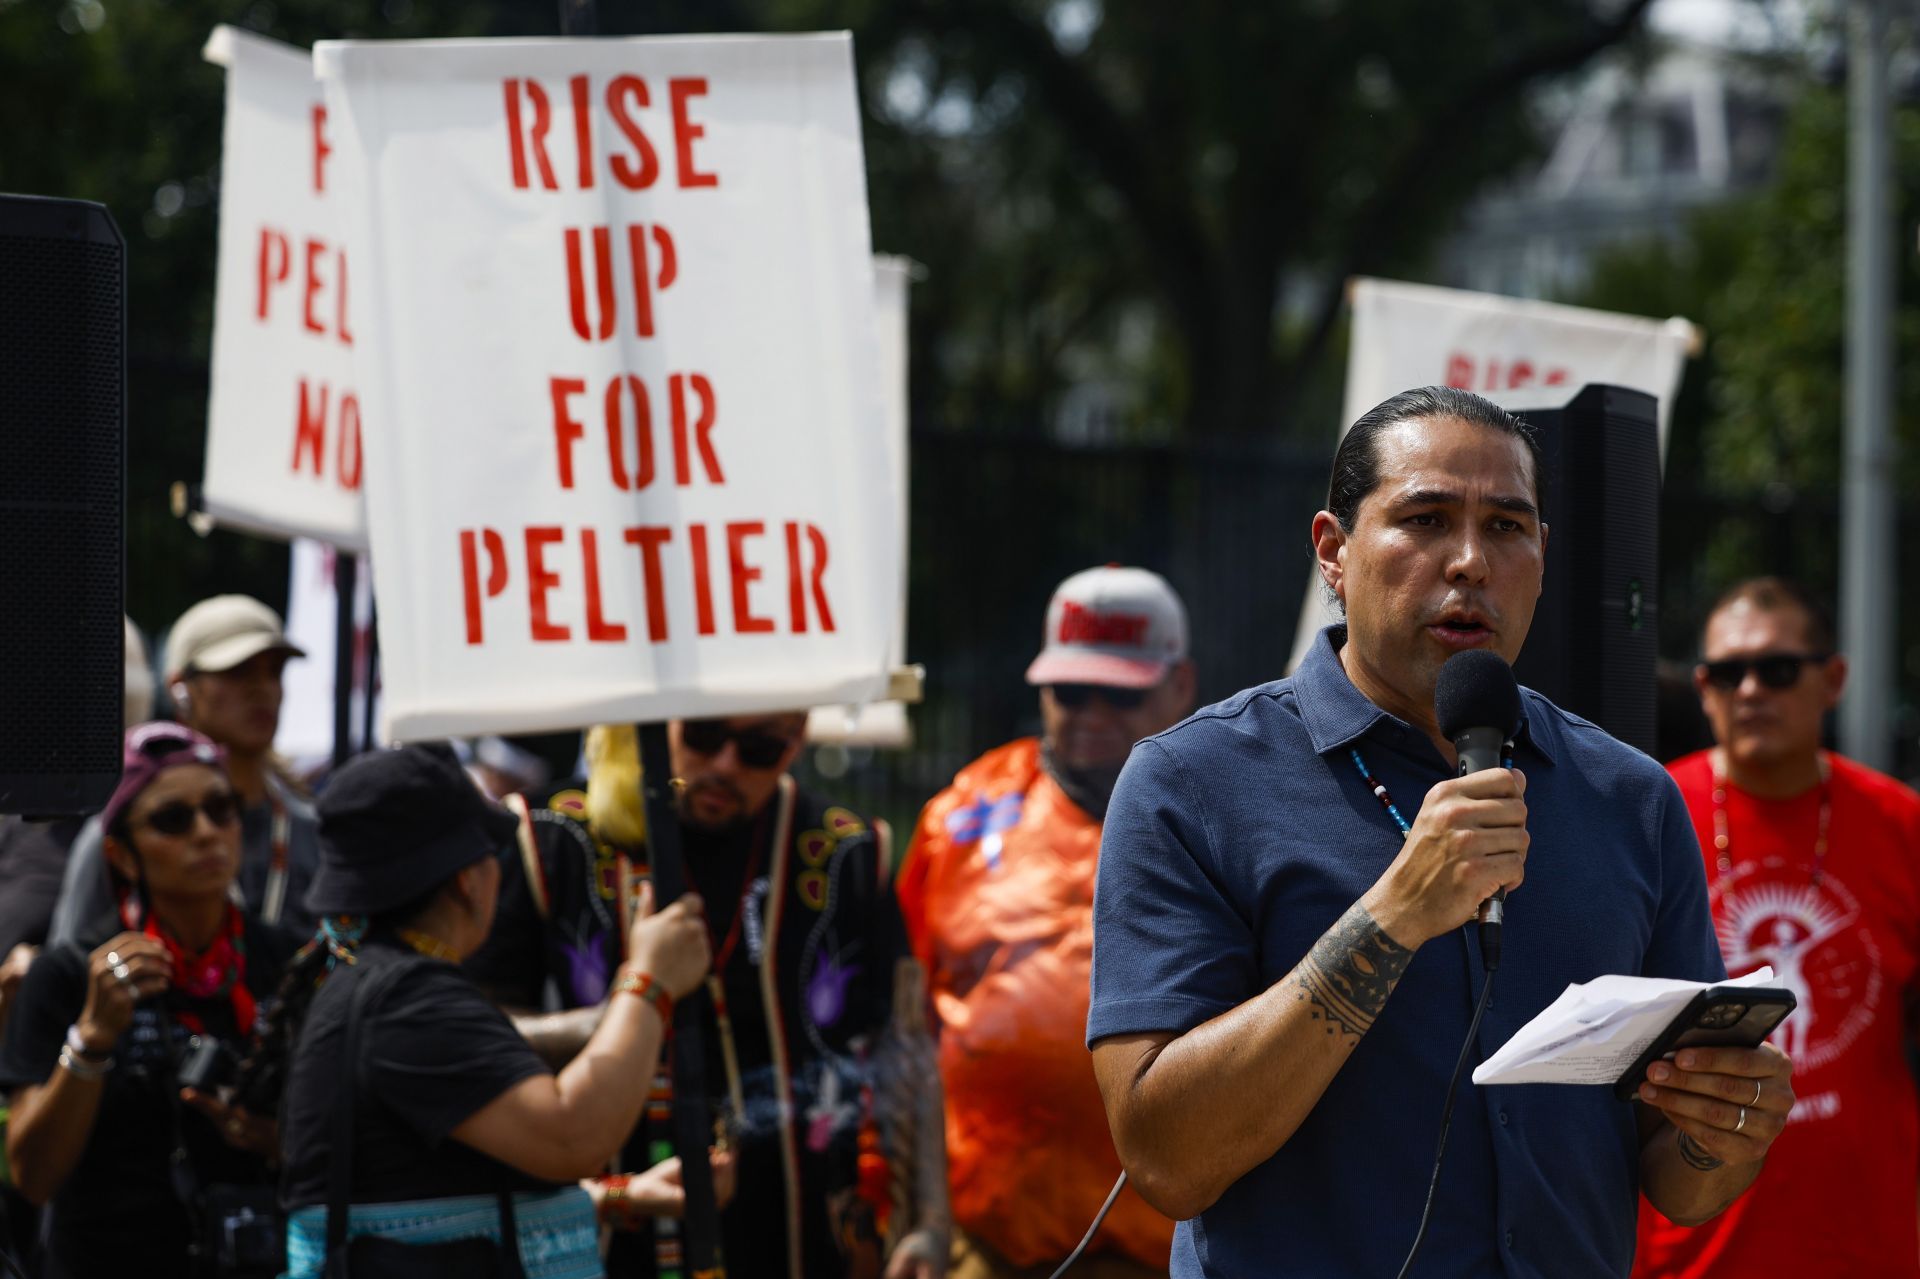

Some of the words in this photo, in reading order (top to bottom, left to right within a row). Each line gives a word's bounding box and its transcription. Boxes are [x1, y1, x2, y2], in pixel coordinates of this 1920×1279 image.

[503, 74, 719, 192] RISE
[563, 223, 678, 341] UP
[548, 373, 726, 492] FOR
[459, 520, 837, 646] PELTIER
